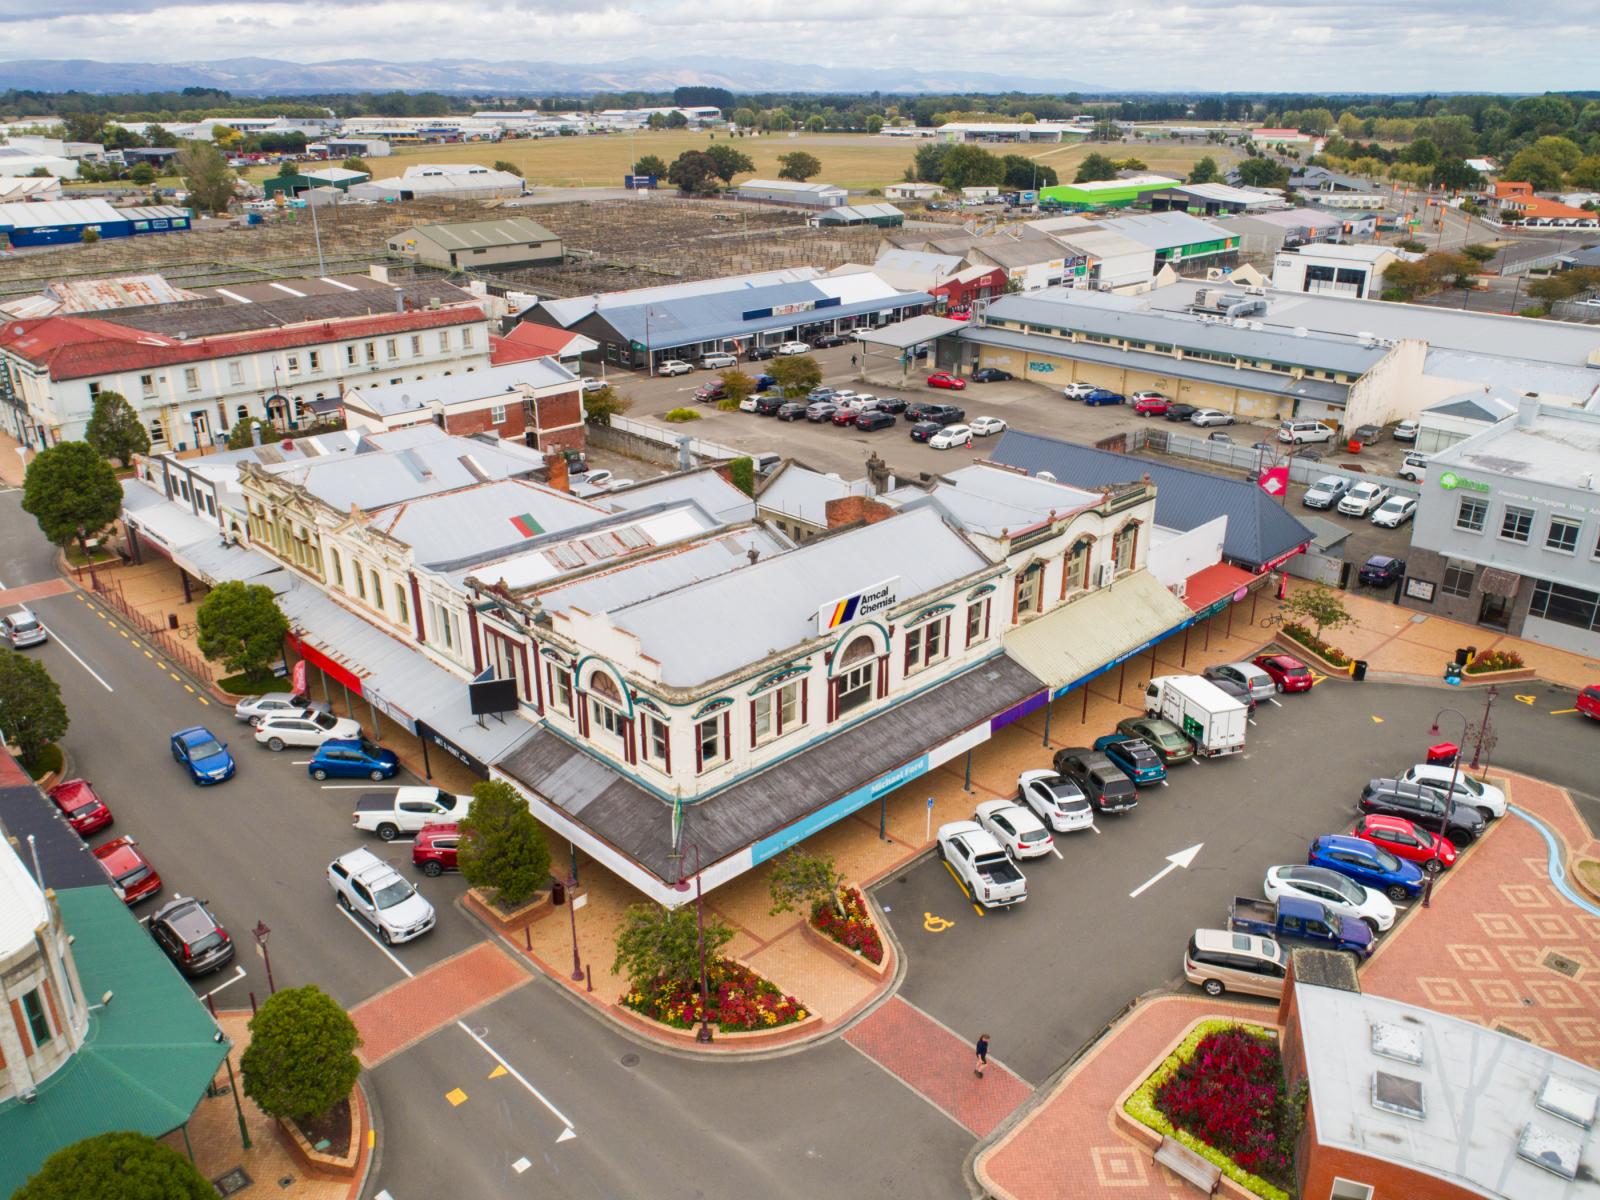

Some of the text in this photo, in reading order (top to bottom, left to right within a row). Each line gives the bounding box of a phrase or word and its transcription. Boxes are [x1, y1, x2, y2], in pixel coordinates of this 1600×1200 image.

[860, 595, 896, 616] Chemist
[861, 586, 889, 605] Amcal
[871, 760, 924, 794] Michael Ford
